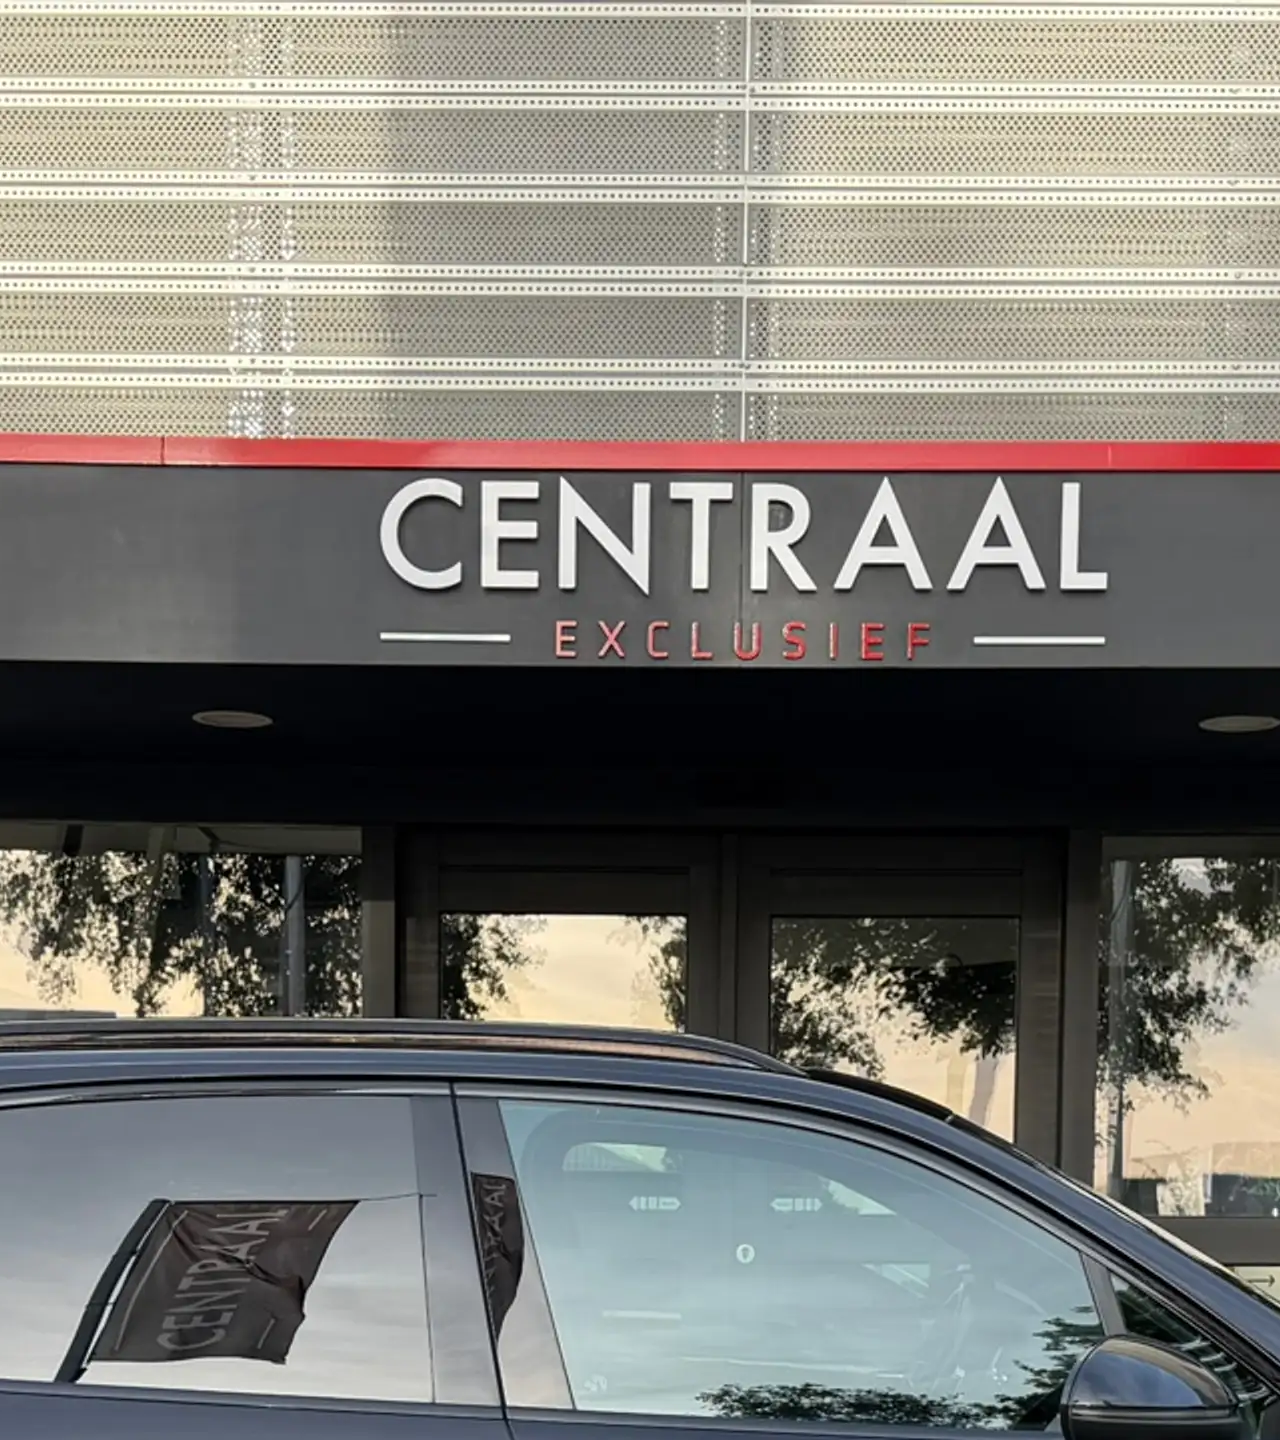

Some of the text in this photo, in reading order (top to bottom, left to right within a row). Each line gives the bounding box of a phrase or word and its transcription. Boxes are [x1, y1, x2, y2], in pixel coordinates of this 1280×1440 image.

[380, 476, 1109, 596] CENTRAAL
[554, 620, 932, 662] EXCLUSIEF
[157, 1208, 289, 1352] CENTRAAL
